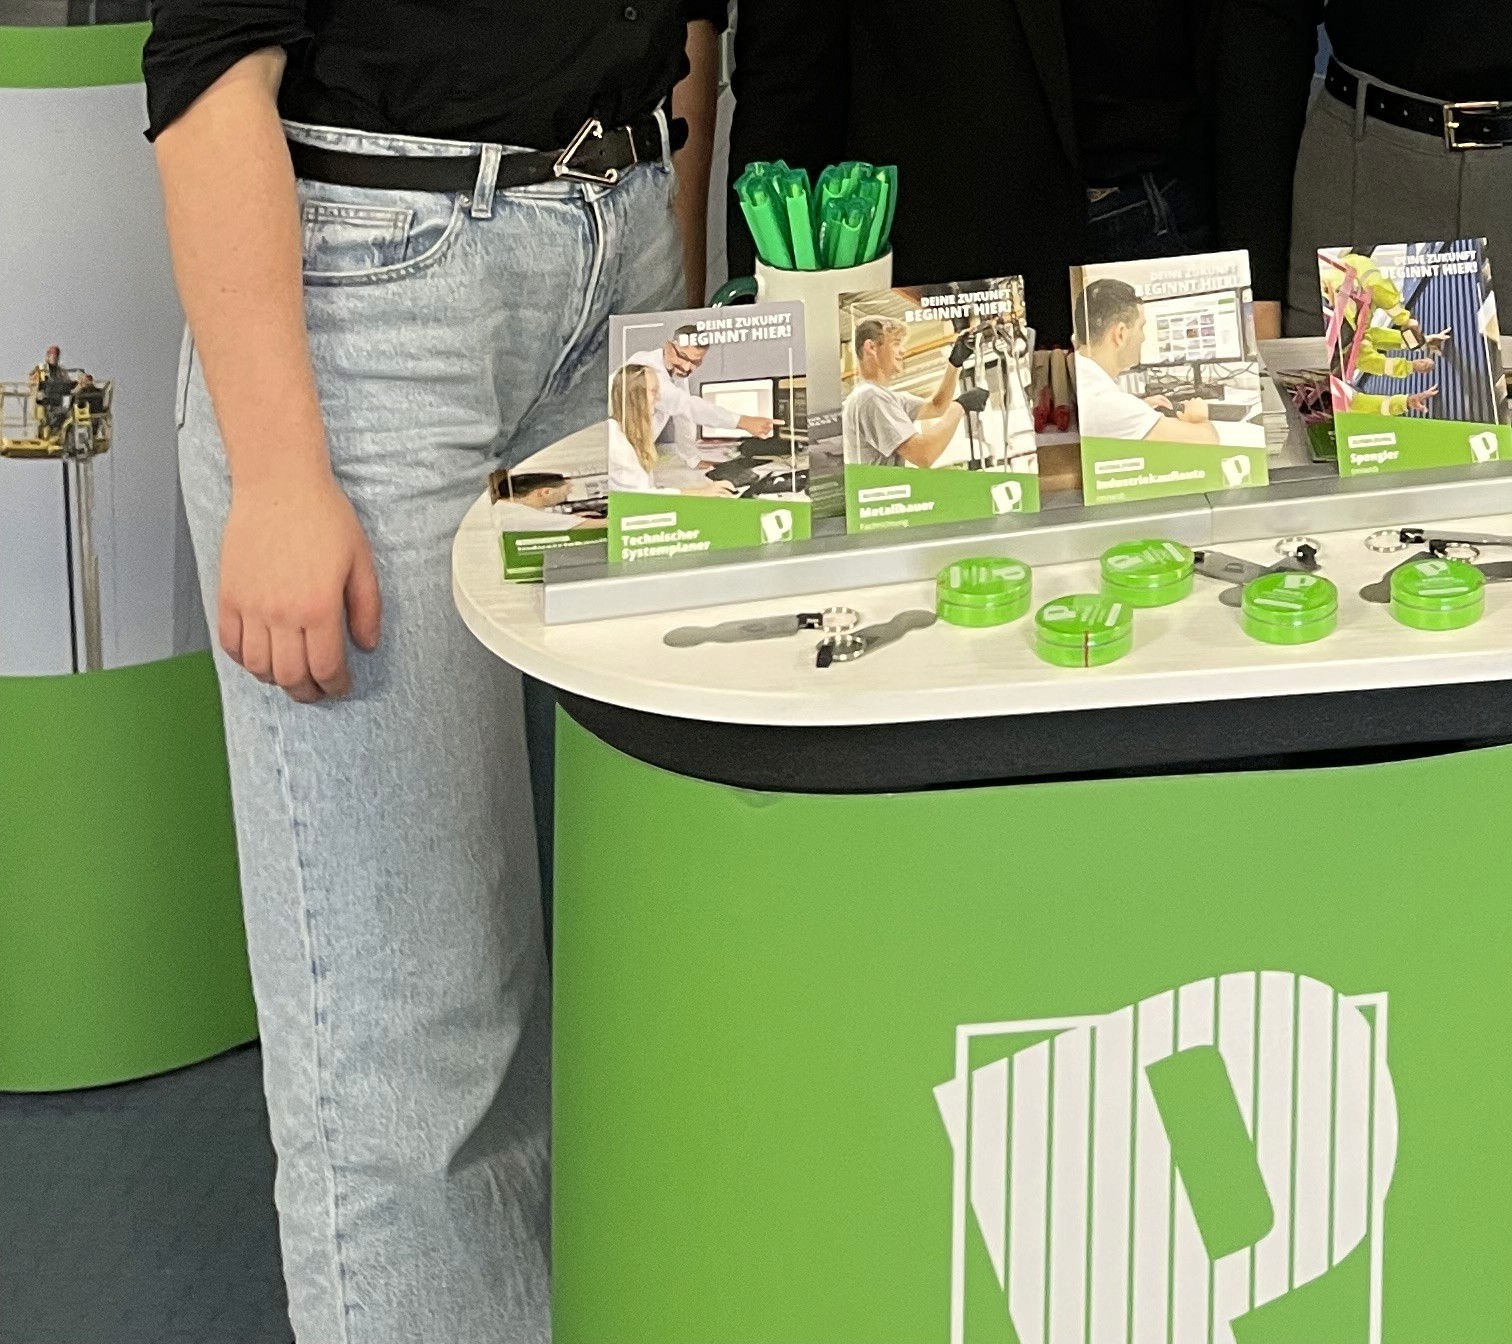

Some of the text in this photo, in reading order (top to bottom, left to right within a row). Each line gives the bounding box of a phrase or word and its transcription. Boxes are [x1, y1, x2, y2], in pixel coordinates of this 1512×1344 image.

[1427, 251, 1477, 264] ZUKUNFT
[1381, 261, 1478, 280] BEGINNT HIER!
[921, 289, 1011, 308] DEINE ZUKUNFT
[905, 300, 1012, 323] BEGINNT HIER!
[696, 313, 791, 332] DEINE ZUKUNFT
[679, 325, 791, 347] BEGINNT HIER!
[1350, 450, 1399, 465] Spengler
[621, 529, 700, 546] Technischer
[621, 541, 711, 562] Systemplaner
